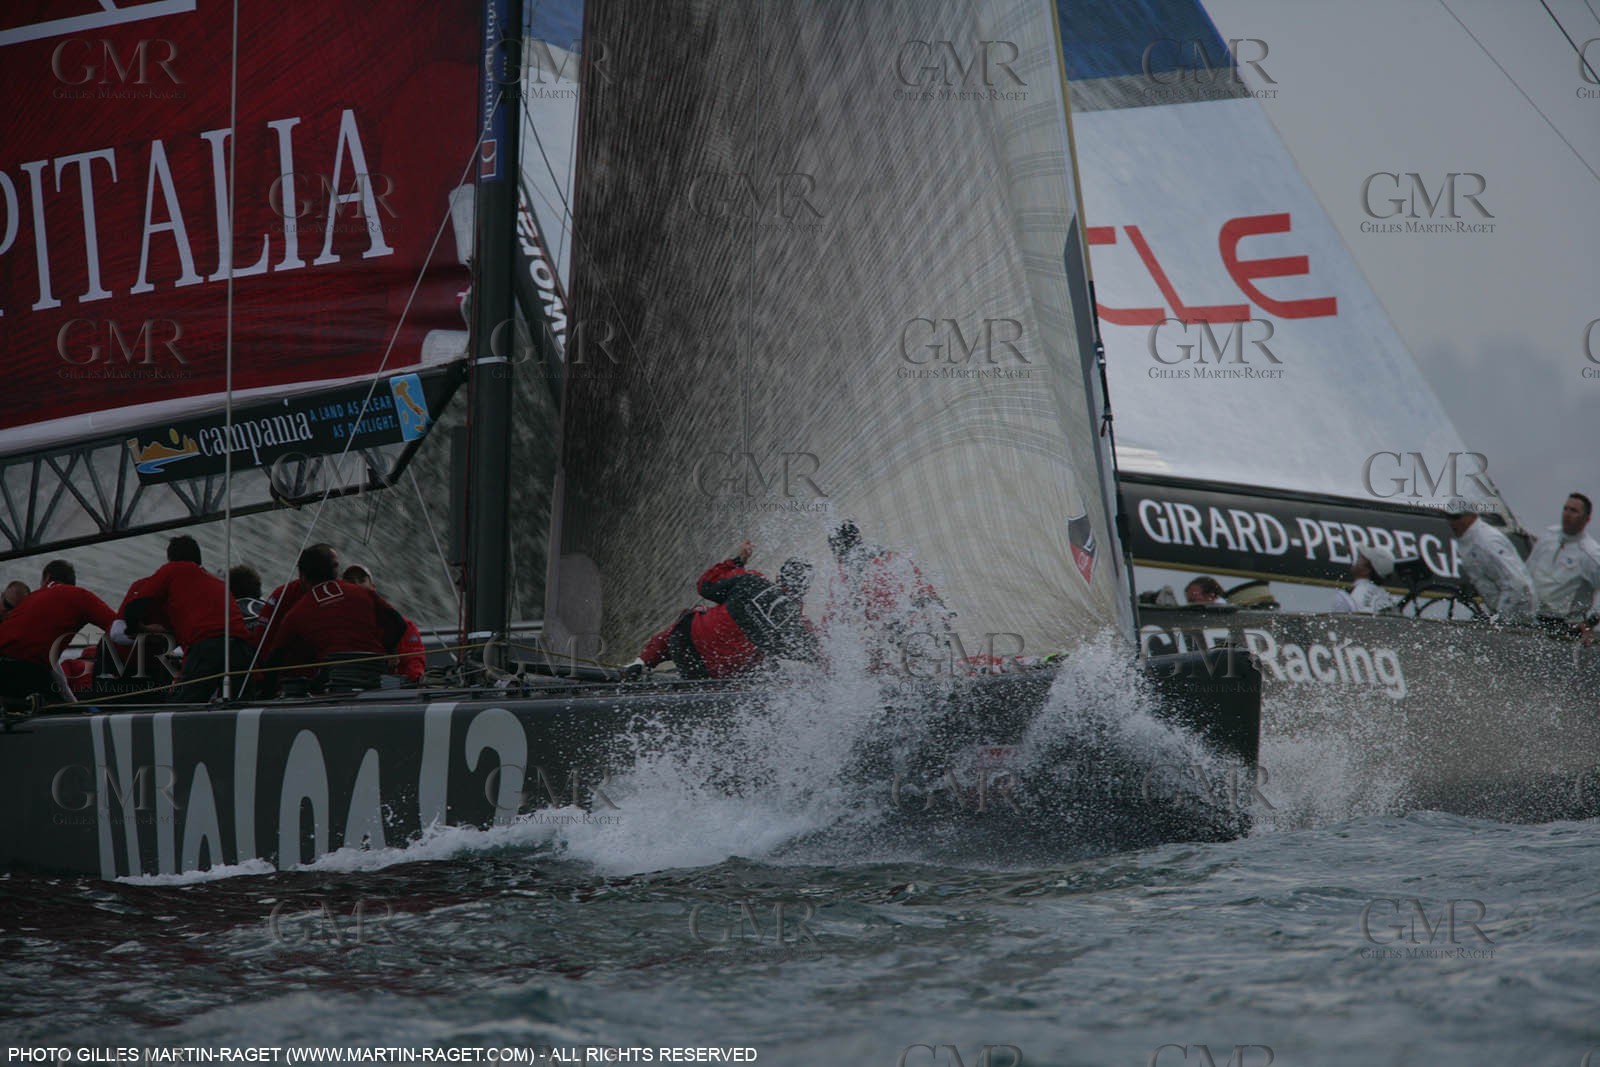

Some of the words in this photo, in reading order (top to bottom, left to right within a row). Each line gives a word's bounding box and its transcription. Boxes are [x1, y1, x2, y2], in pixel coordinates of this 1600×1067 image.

[309, 408, 317, 422] A
[319, 404, 344, 421] LAND
[347, 401, 360, 416] AS
[362, 395, 393, 413] CLEAR
[333, 423, 345, 438] AS
[199, 403, 313, 465] campania
[1243, 629, 1408, 699] Racing
